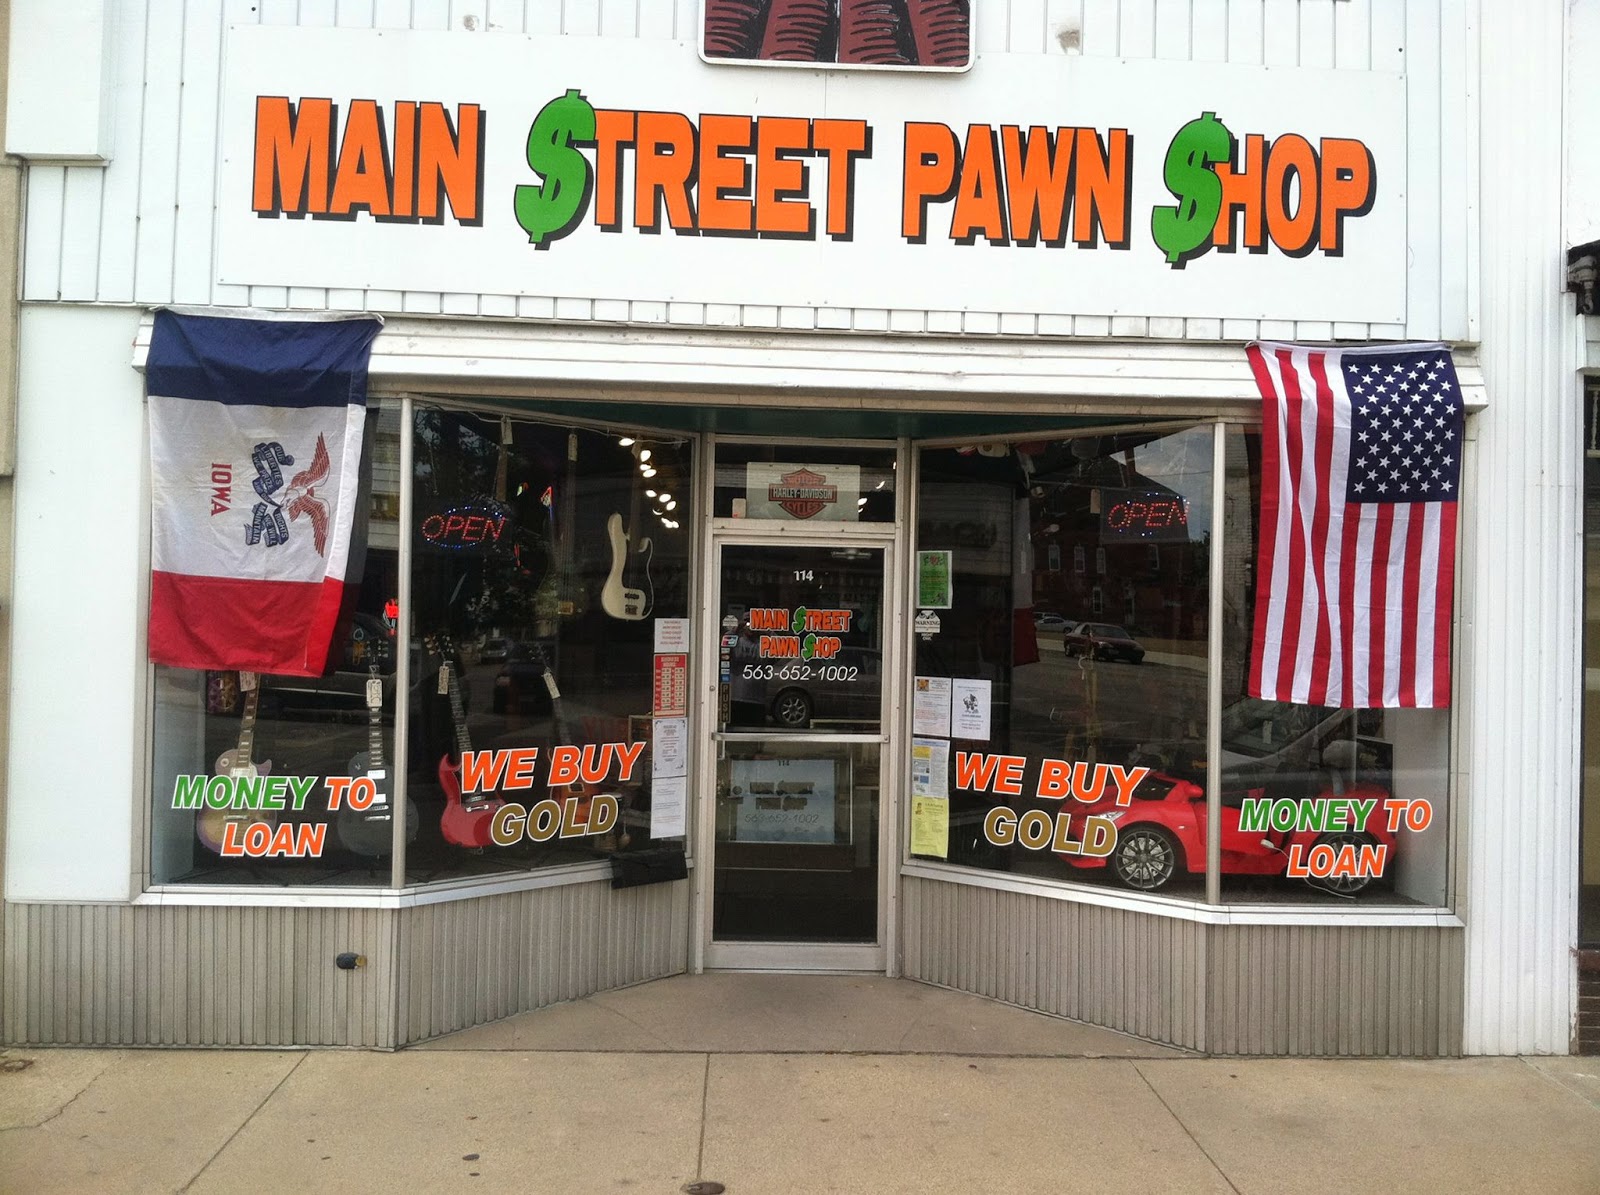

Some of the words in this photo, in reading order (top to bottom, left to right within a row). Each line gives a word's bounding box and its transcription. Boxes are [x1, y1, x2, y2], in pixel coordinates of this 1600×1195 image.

[252, 95, 486, 227] MAIN
[901, 121, 1134, 250] PAWN
[261, 445, 283, 486] LIBERTIES
[212, 463, 231, 515] IOWA
[772, 487, 833, 500] HARLEY-DAVIDSON
[252, 504, 267, 544] MAINTAIN
[274, 513, 287, 539] RIGHTS
[422, 514, 506, 541] OPEN
[1107, 501, 1190, 528] OPEN
[793, 569, 814, 581] 114
[750, 607, 789, 631] MAIN
[759, 635, 801, 659] PAWN
[742, 664, 858, 682] 563-652-1002
[461, 748, 539, 794] WE
[547, 741, 647, 787] BUY
[955, 752, 1026, 795] WE
[1036, 759, 1150, 807] BUY
[171, 775, 319, 810] MONEY
[324, 777, 377, 811] TO
[490, 794, 619, 846] GOLD
[983, 806, 1118, 857] GOLD
[1238, 798, 1378, 832] MONEY
[1384, 799, 1433, 832] TO
[220, 822, 328, 858] LOAN
[1286, 844, 1388, 878] LOAN
